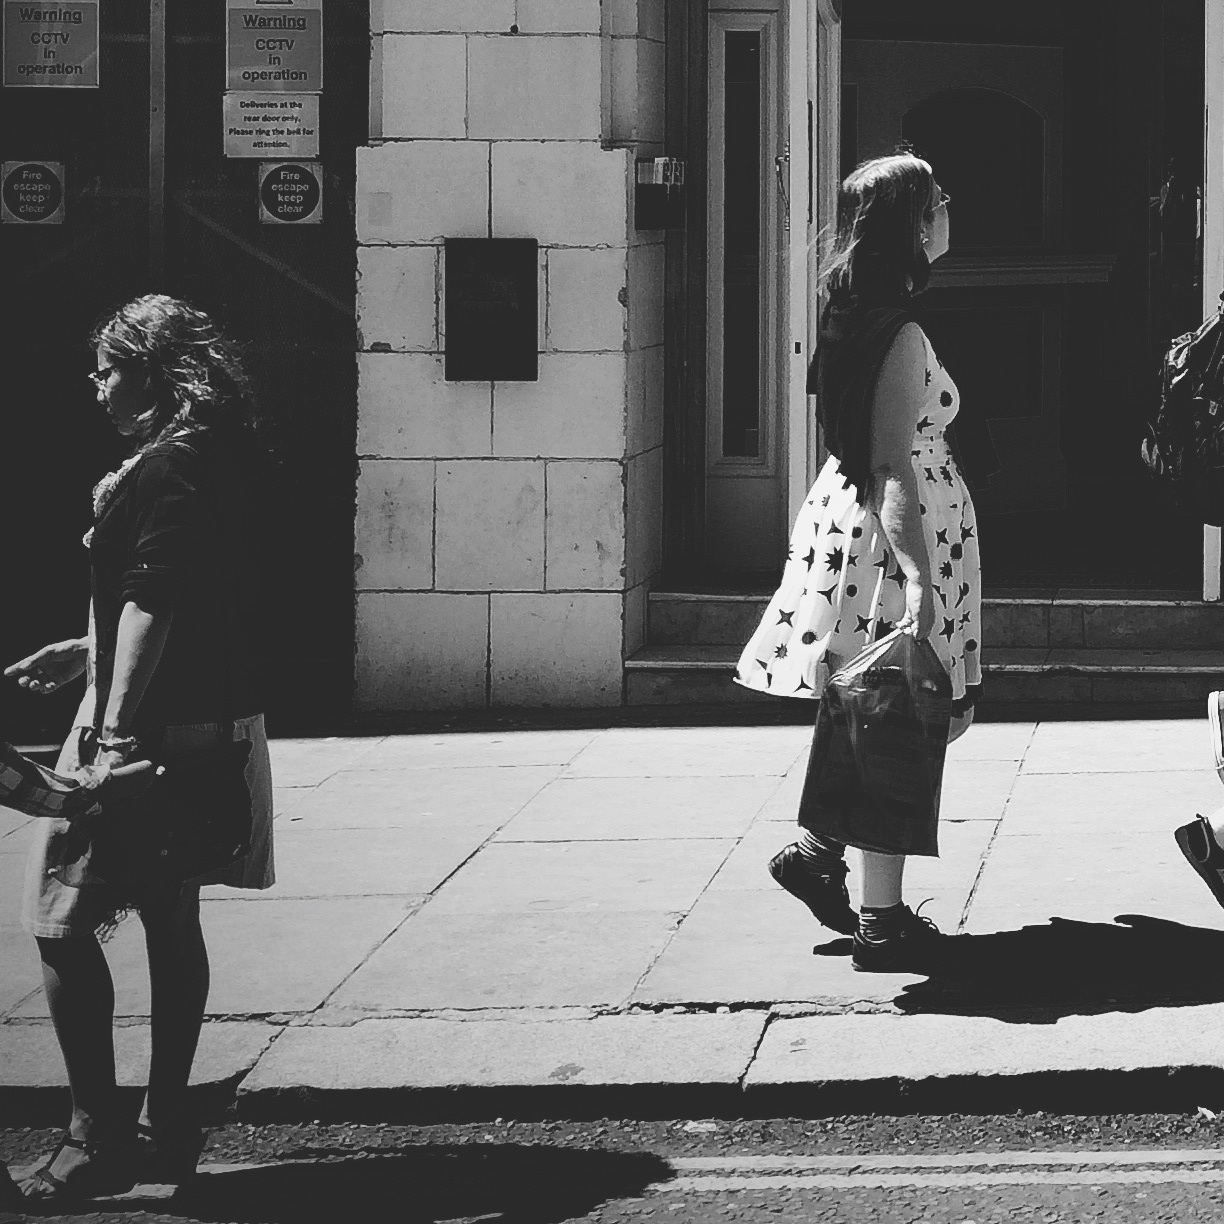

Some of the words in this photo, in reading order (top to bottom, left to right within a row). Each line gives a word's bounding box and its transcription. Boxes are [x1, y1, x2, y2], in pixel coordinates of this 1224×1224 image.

[20, 7, 82, 25] Warning
[243, 14, 307, 30] Warning
[30, 32, 69, 44] CCTV
[255, 38, 294, 51] CCTV
[43, 47, 55, 59] in
[268, 53, 281, 65] in
[17, 62, 83, 76] operation
[242, 69, 307, 82] operation
[239, 100, 278, 109] Deliveries
[279, 101, 288, 109] at
[289, 101, 303, 109] the
[261, 114, 280, 122] door
[228, 127, 254, 136] Please
[254, 127, 271, 137] ring
[271, 127, 285, 135] the
[286, 127, 301, 136] bell
[302, 127, 314, 135] for
[22, 170, 42, 180] Fire
[280, 171, 301, 180] Fire
[13, 183, 51, 193] escape
[271, 183, 309, 193] escape
[19, 193, 45, 203] keep
[277, 193, 304, 204] keep
[19, 204, 45, 213] clear
[277, 204, 304, 213] clear
